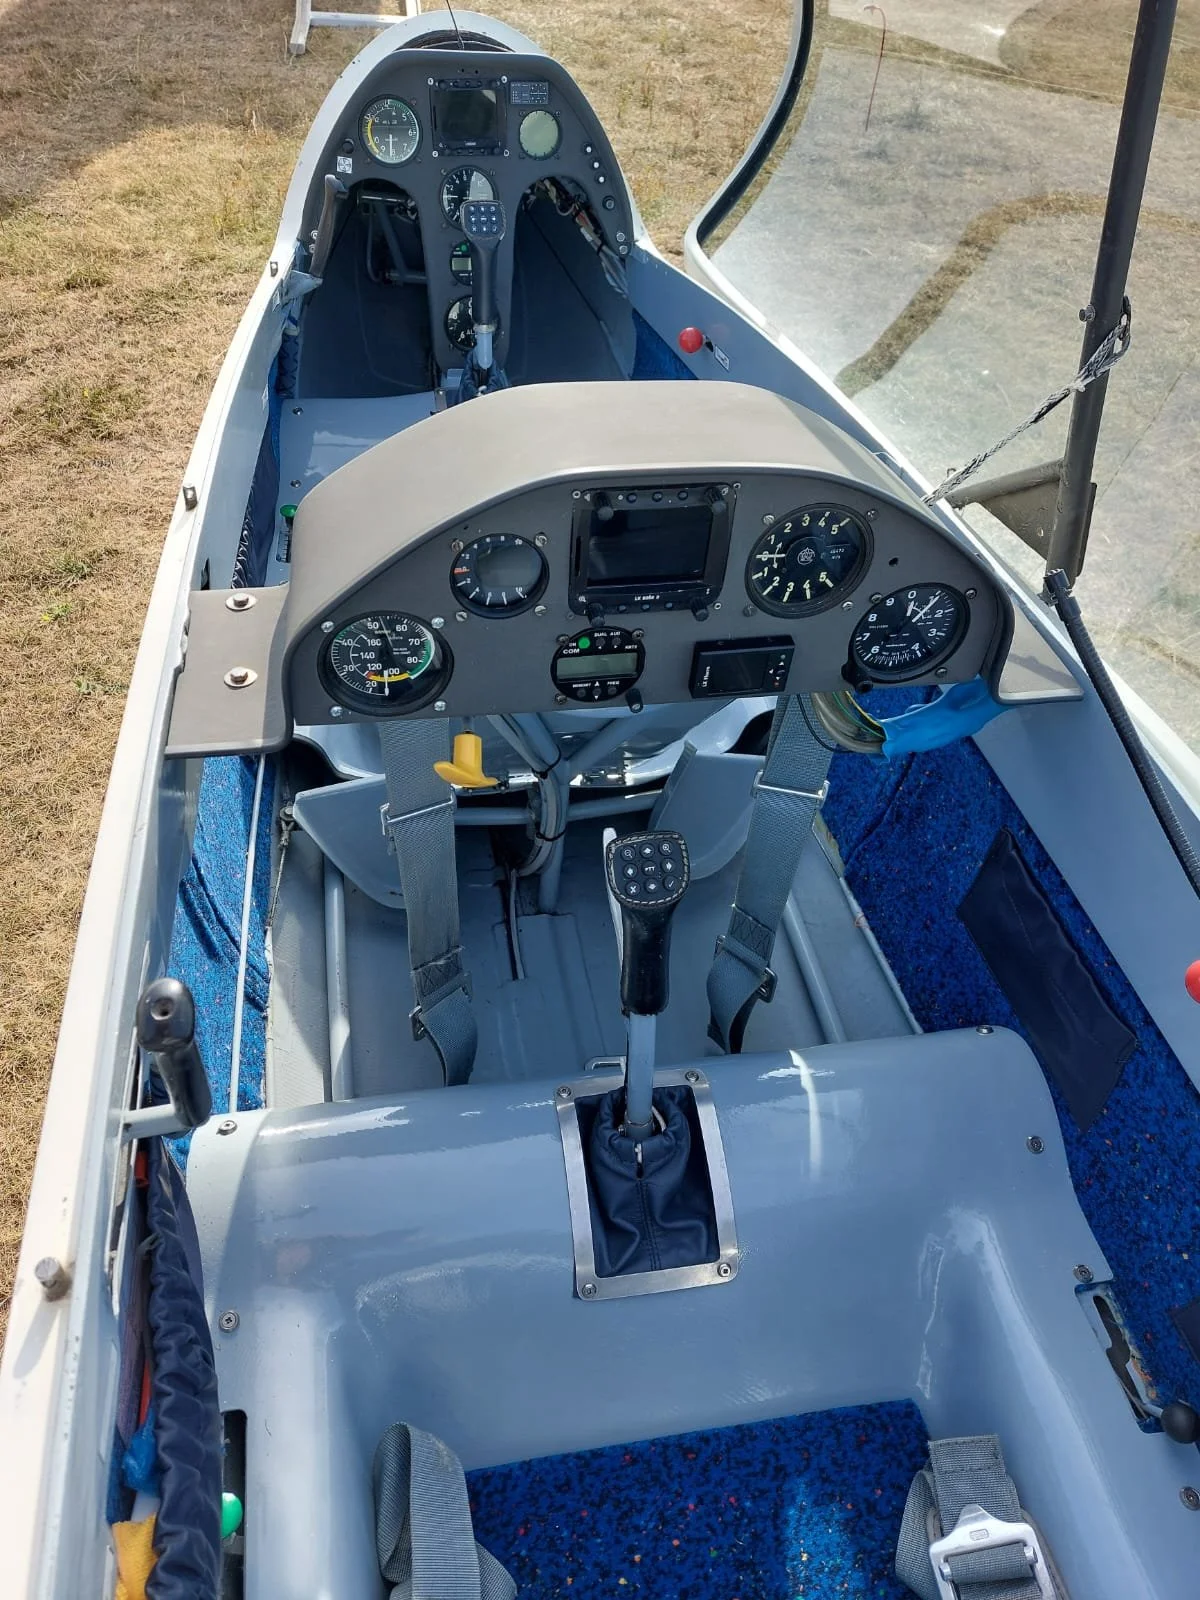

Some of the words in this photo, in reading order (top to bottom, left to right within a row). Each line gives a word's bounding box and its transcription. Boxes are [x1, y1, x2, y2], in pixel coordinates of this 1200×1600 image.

[802, 516, 810, 526] 3
[818, 517, 826, 527] 4
[784, 523, 792, 532] 2
[830, 525, 839, 534] 5
[770, 535, 775, 544] 1
[764, 567, 768, 576] 1
[772, 576, 780, 586] 2
[820, 572, 827, 581] 5
[787, 582, 794, 592] 3
[803, 580, 810, 589] 4
[886, 598, 894, 606] 9
